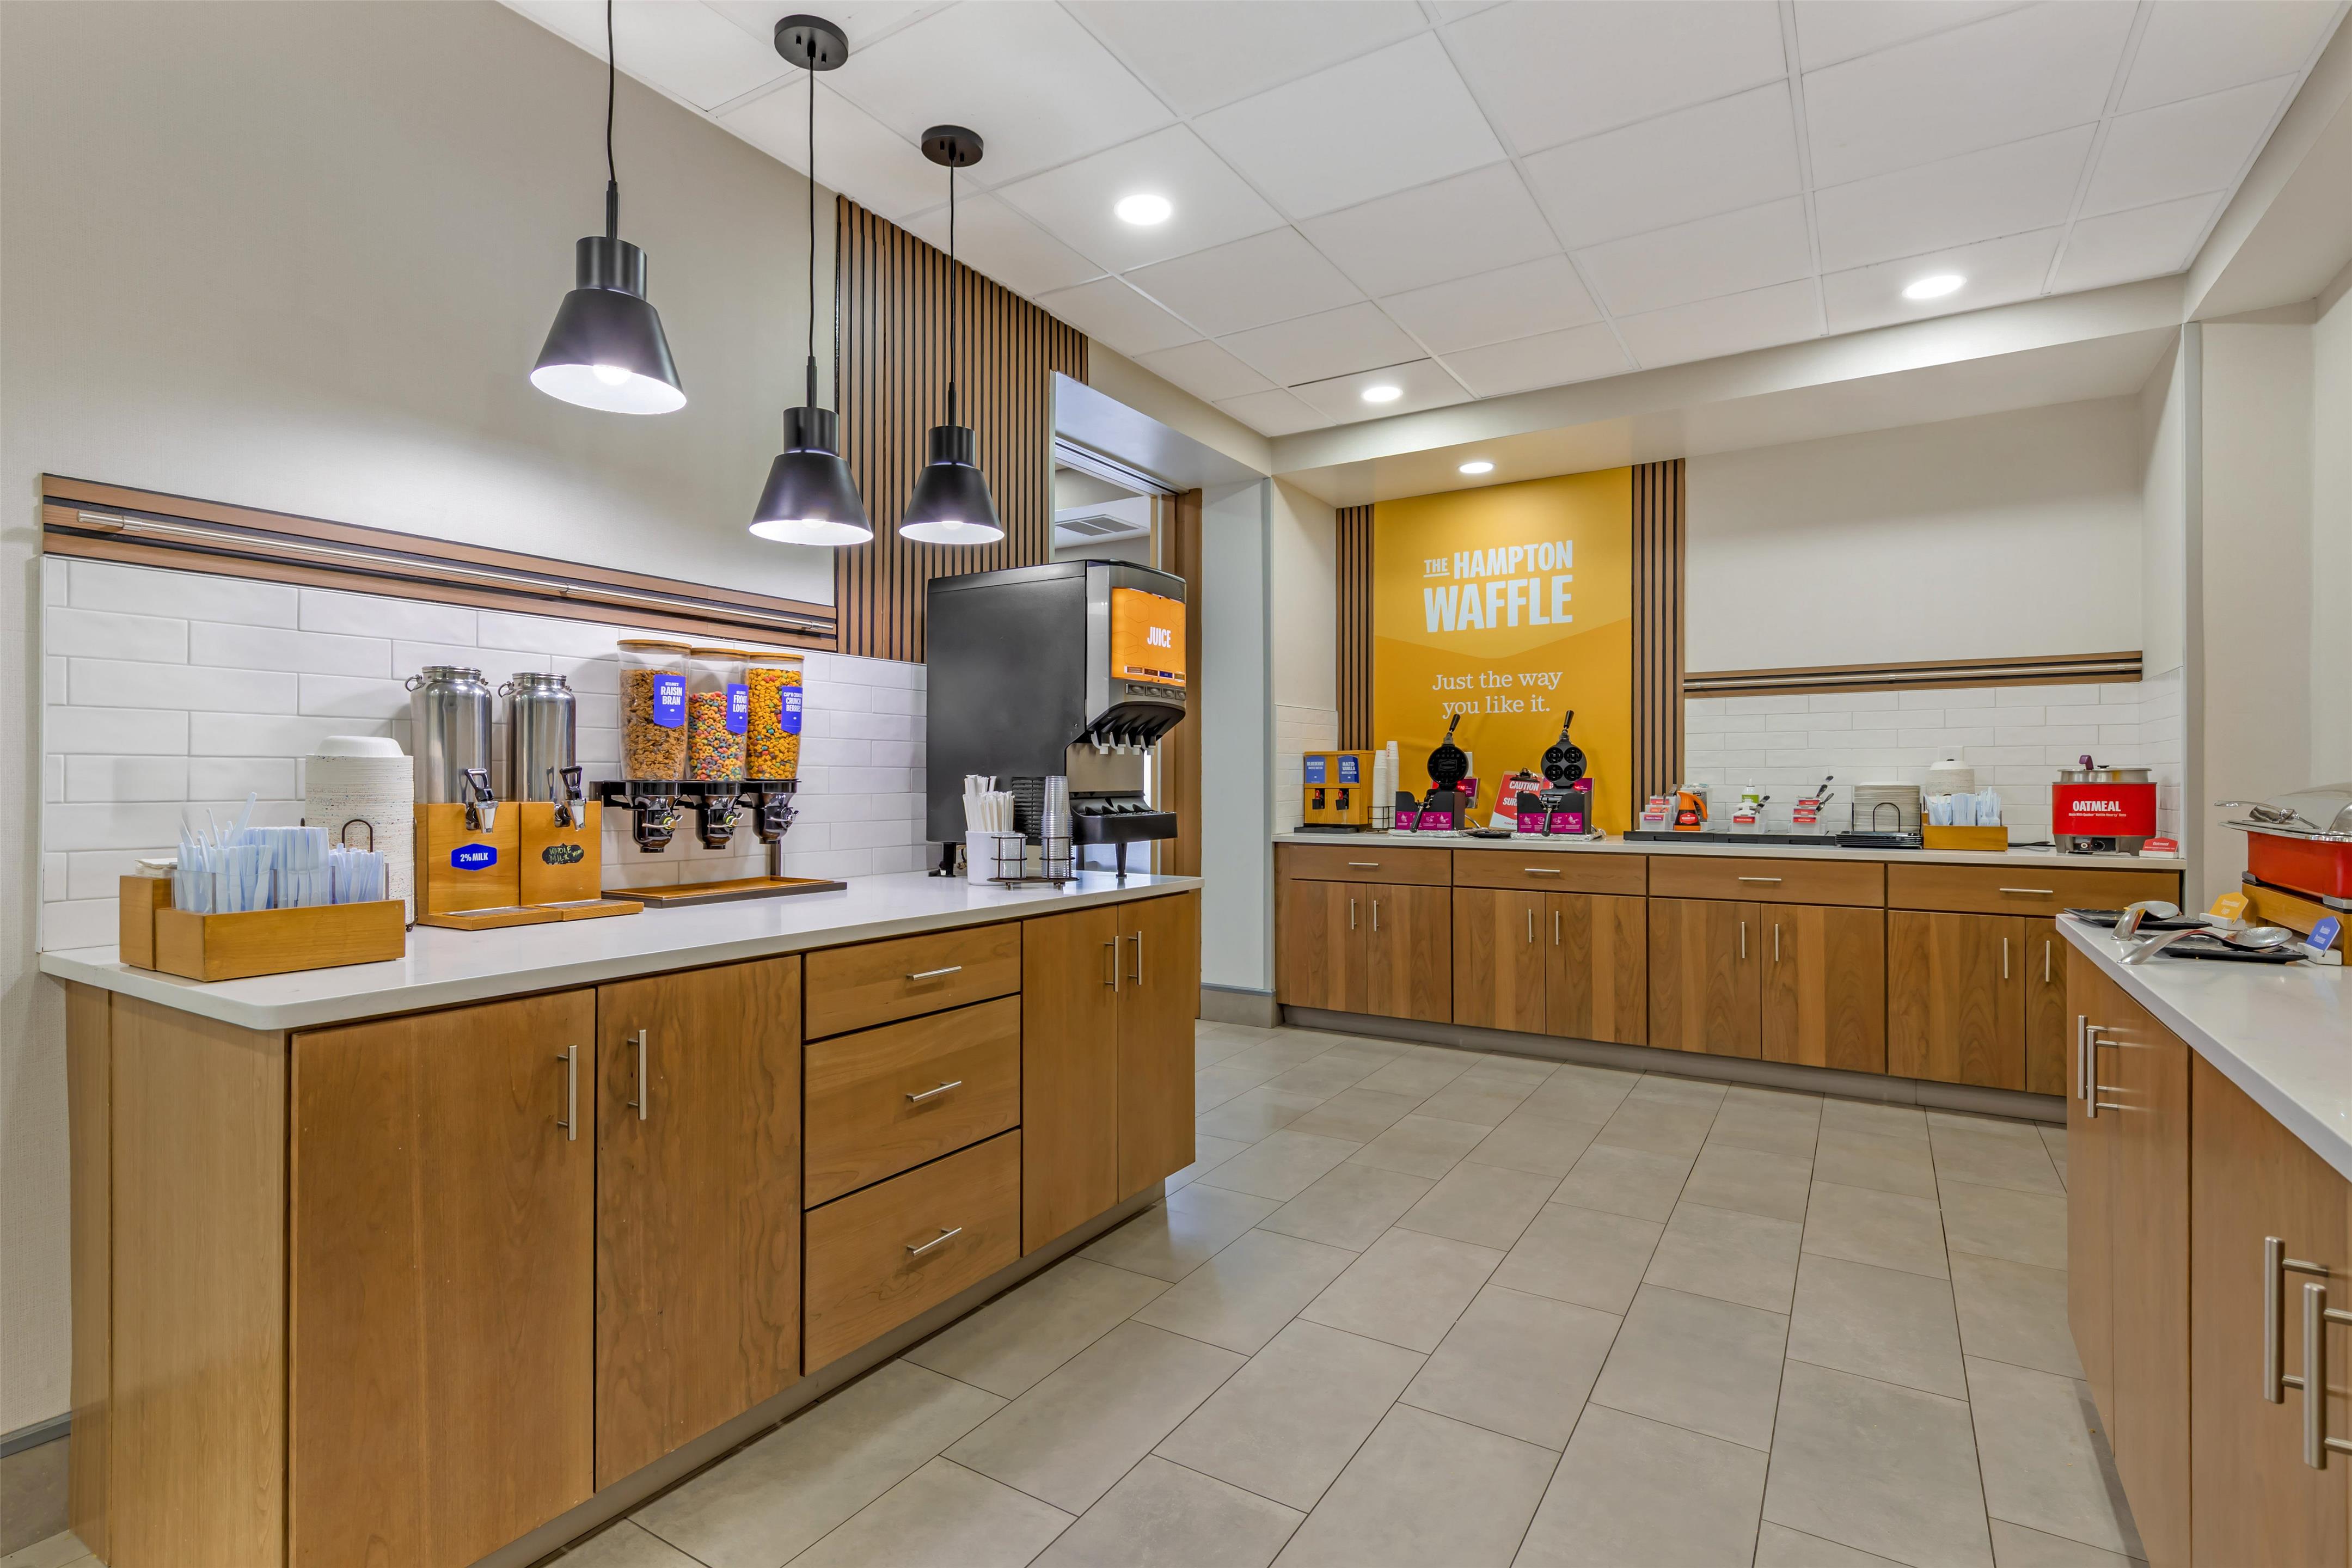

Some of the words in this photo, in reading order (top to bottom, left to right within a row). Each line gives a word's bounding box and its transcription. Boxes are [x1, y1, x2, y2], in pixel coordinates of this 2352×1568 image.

[1424, 558, 1448, 573] THE
[1454, 540, 1573, 579] HAMPTON
[1424, 574, 1573, 633] WAFFLE
[1147, 626, 1171, 648] JUICE
[1432, 673, 1474, 690] Just
[1479, 670, 1512, 688] the
[1517, 671, 1563, 690] way
[660, 686, 682, 696] RAISIN
[662, 696, 681, 705] BRAN
[733, 703, 747, 713] LOOPS
[1442, 701, 1480, 719] you
[1485, 695, 1524, 714] like
[1530, 694, 1551, 712] it.
[1509, 781, 1540, 791] CAUTION
[2073, 800, 2122, 812] OATMEAL
[549, 846, 572, 854] WHOLE
[460, 854, 471, 862] 2%
[472, 852, 488, 861] MILK
